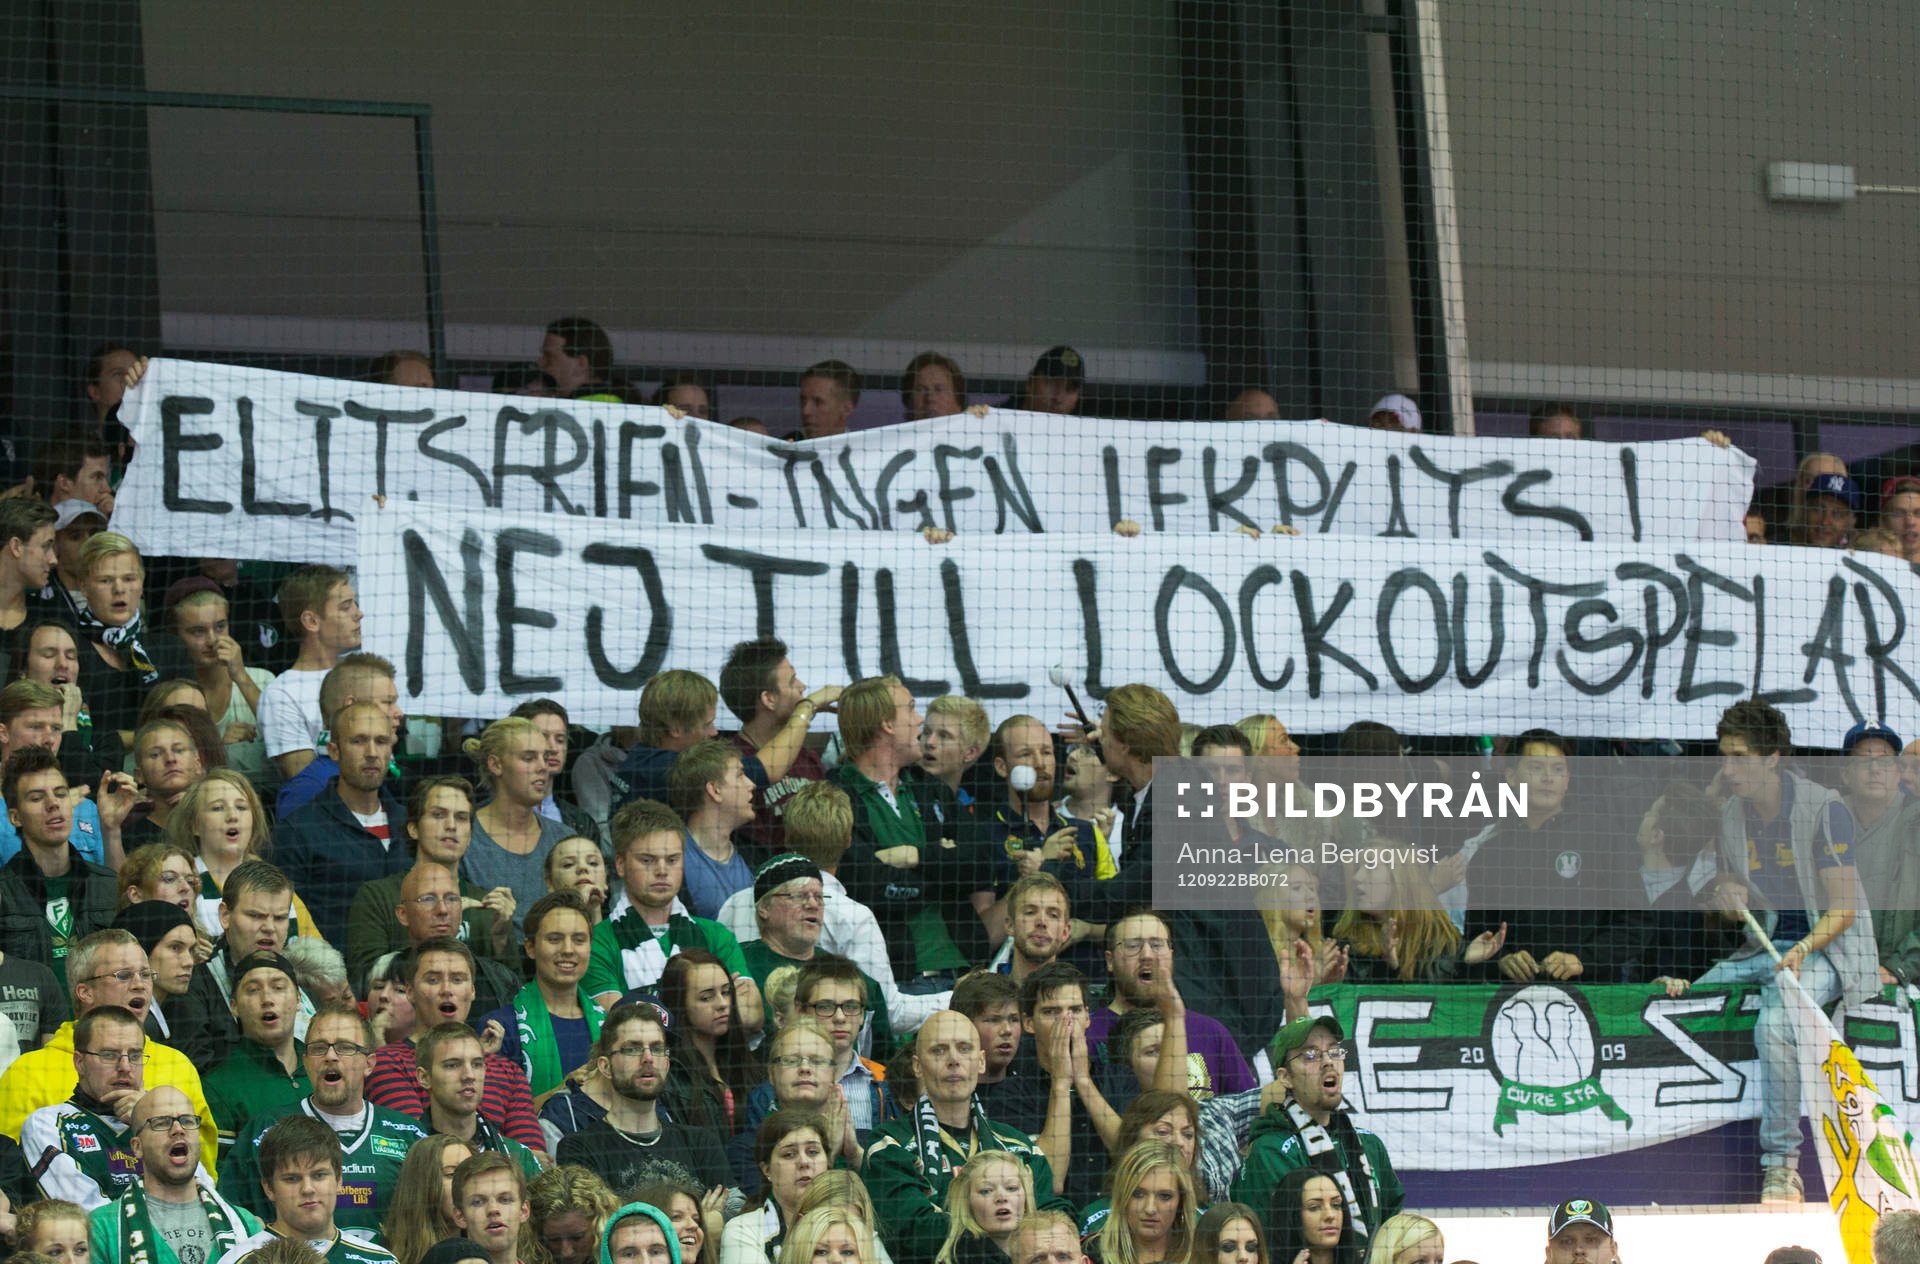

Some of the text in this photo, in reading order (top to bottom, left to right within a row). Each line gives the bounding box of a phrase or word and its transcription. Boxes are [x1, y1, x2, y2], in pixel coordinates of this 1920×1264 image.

[402, 527, 674, 698] NEJ
[701, 543, 1031, 699] TILL
[1460, 1047, 1485, 1064] 20
[1601, 1043, 1626, 1061] 09
[341, 1163, 376, 1174] adium
